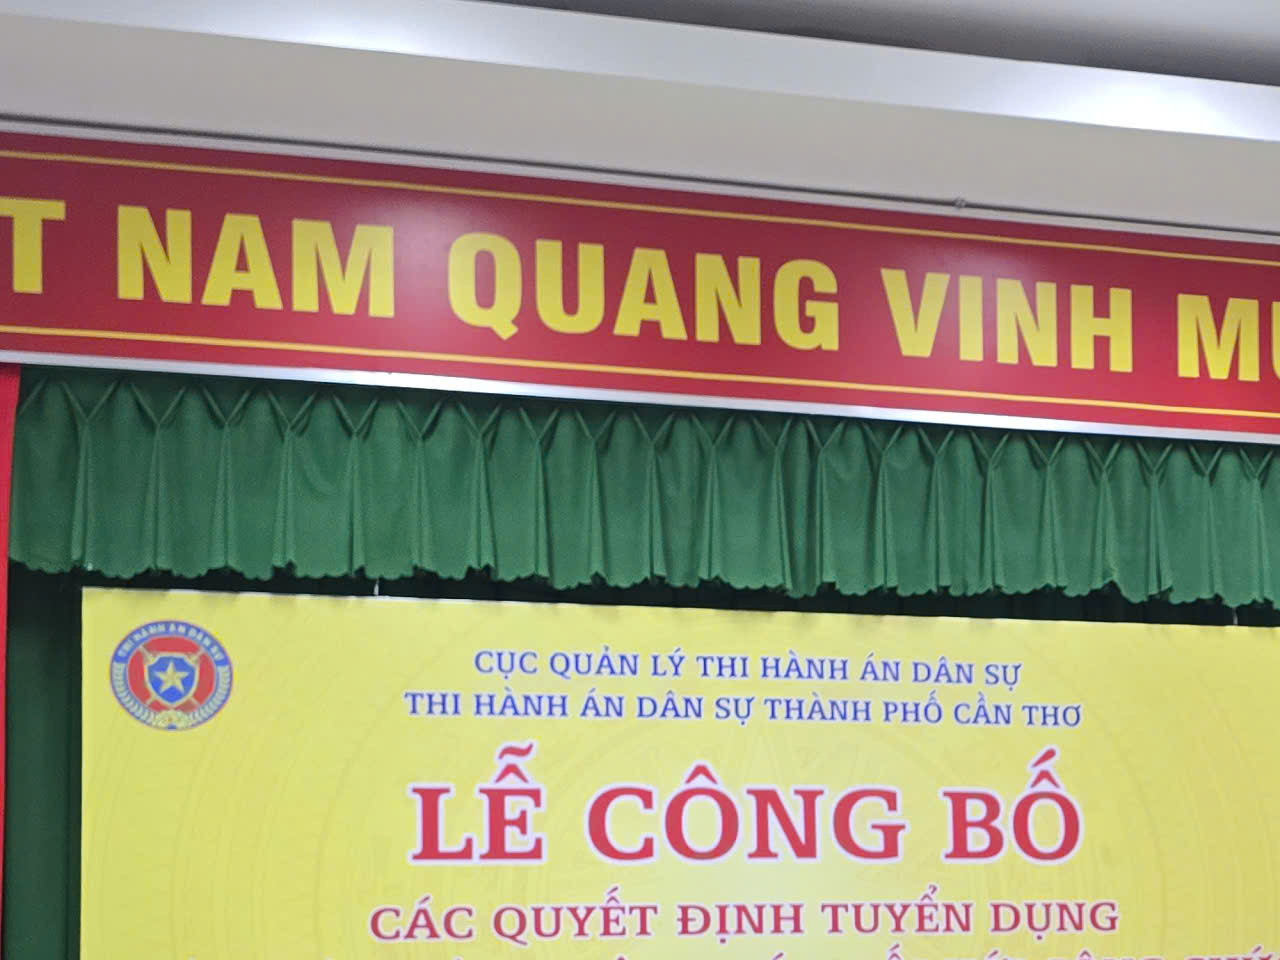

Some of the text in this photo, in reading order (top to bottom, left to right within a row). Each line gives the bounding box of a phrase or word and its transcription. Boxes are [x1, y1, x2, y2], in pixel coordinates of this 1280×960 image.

[117, 205, 395, 319] NAM
[447, 231, 840, 351] QUANG
[880, 267, 1134, 373] VINH
[474, 645, 1023, 692] CỤC QUẢN LÝ THI HÀNH ÁN DÂN SỰ
[404, 686, 1082, 727] THI HÀNH ÁN DÂN SỰ THÀNH PHỐ CẦN THƠ
[412, 743, 1080, 861] LỄ CÔNG BỐ
[370, 885, 1118, 946] CÁC QUYẾT ĐỊNH TUYỂN DỤNG
